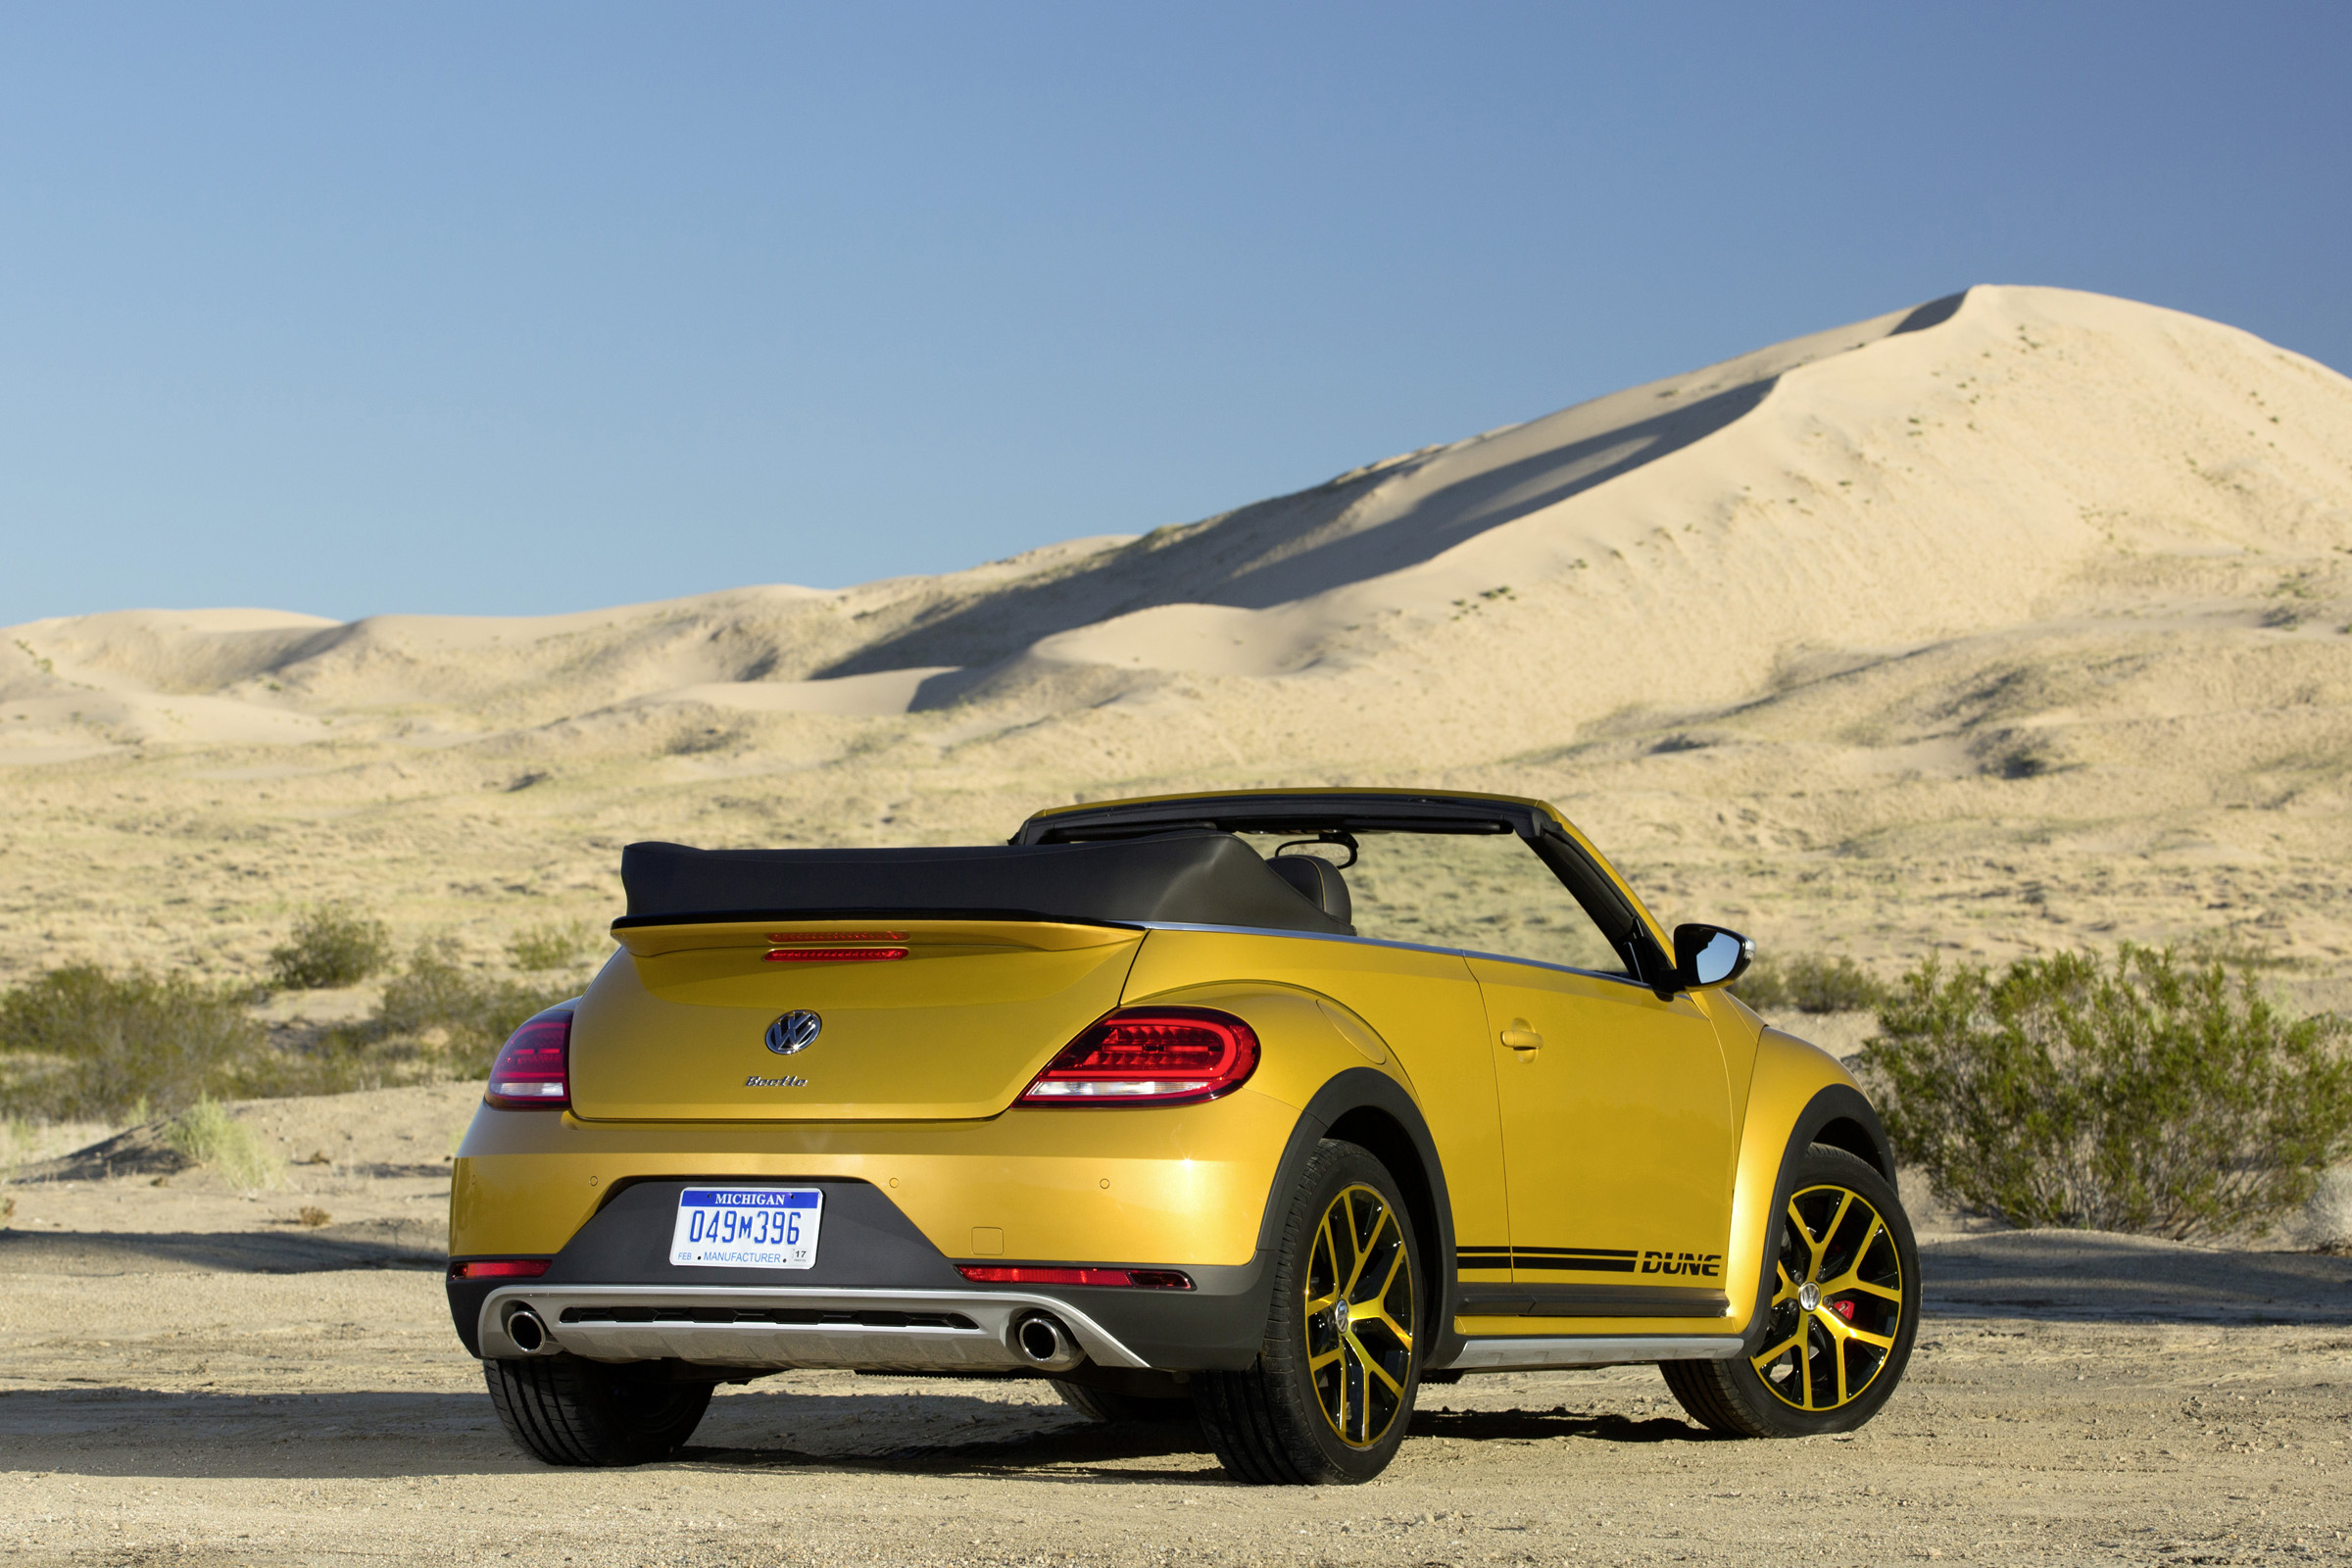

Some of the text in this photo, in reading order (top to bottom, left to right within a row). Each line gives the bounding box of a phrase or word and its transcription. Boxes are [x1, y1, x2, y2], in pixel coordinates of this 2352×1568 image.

[745, 1075, 808, 1087] Beetle
[714, 1193, 785, 1205] MICHIGAN
[689, 1209, 802, 1246] 049M396
[677, 1250, 781, 1263] FEB MANUFACTURER
[1641, 1250, 1722, 1277] DUNE
